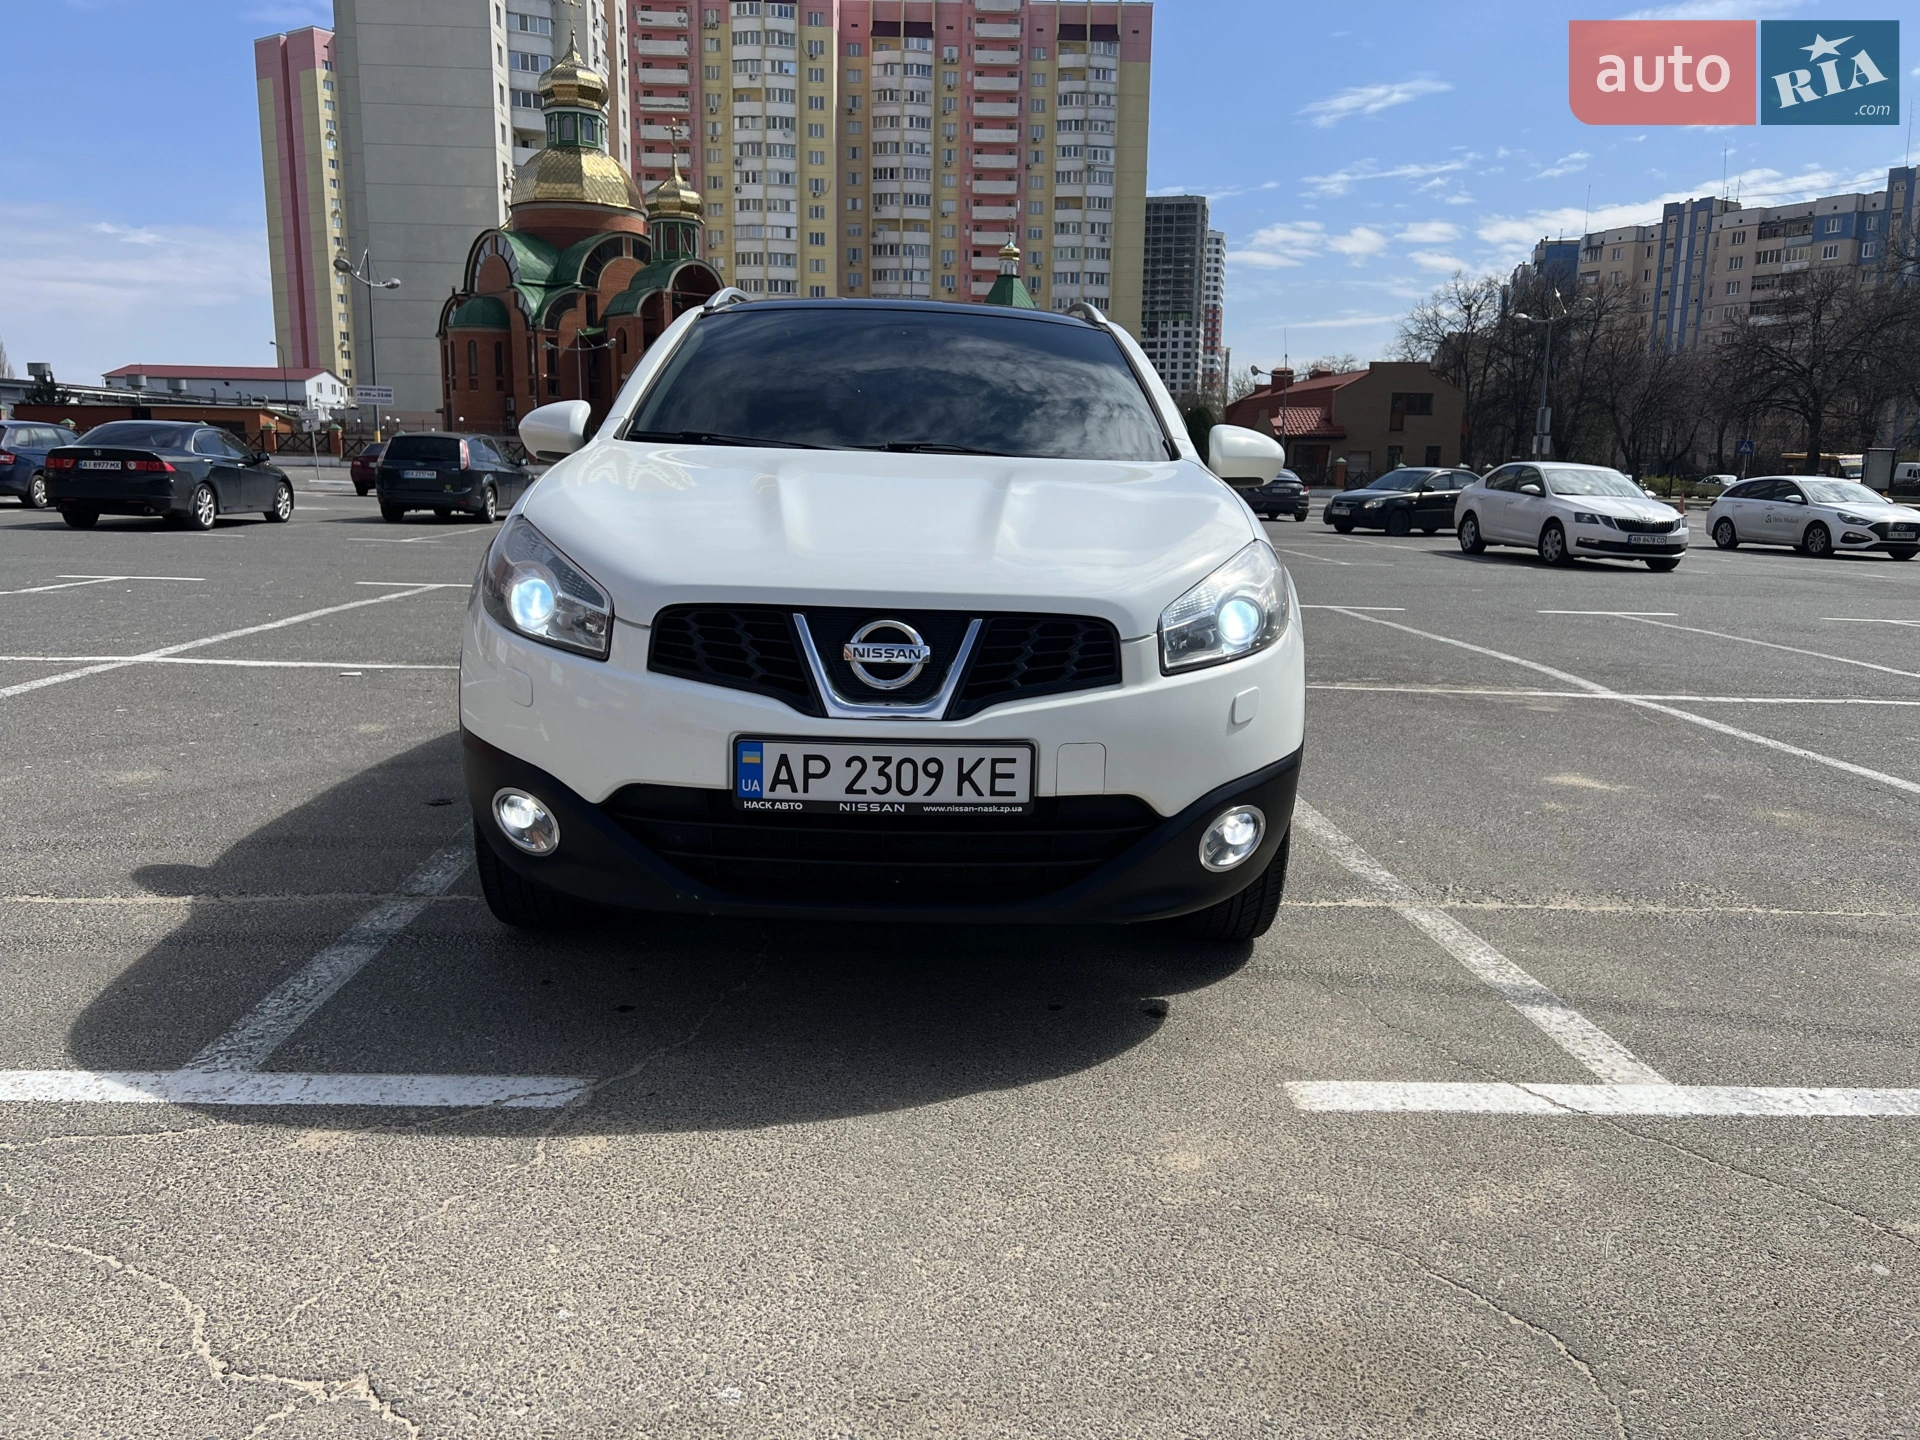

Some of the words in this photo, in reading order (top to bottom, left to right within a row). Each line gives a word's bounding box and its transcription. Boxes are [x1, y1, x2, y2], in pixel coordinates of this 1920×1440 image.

[852, 647, 922, 660] NISSAN
[768, 753, 831, 794] AP
[844, 755, 944, 797] 2309
[956, 757, 1017, 797] KE
[741, 779, 761, 792] UA
[839, 803, 905, 812] NISSAN
[922, 805, 1023, 814] www.nissan-nask.zp.ua
